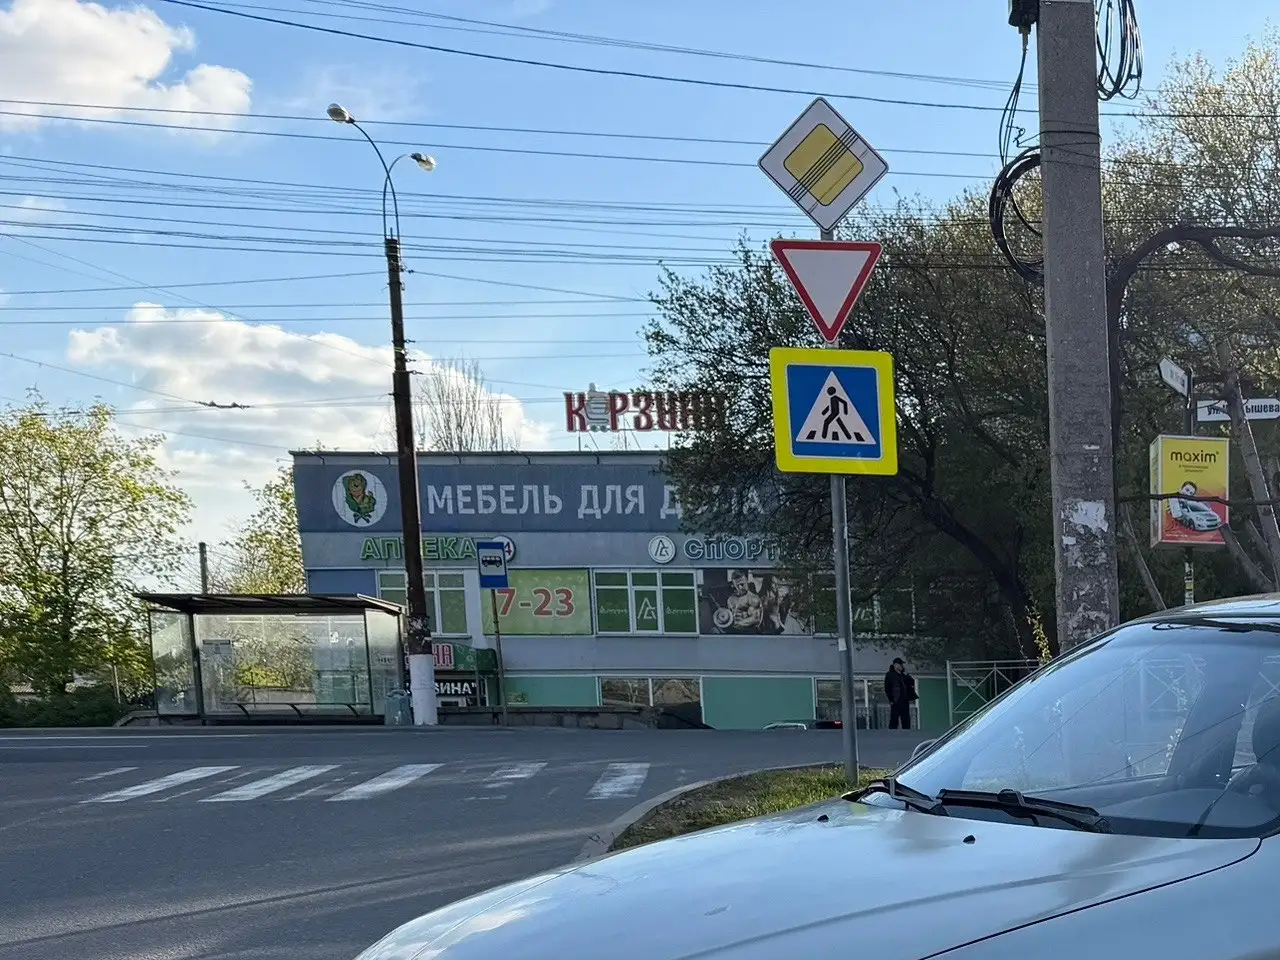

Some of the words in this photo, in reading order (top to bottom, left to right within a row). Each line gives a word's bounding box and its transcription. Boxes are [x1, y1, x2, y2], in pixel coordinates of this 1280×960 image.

[1170, 449, 1217, 463] maxim
[427, 484, 563, 515] МЕБЕЛЬ
[577, 484, 645, 519] ДЛЯ
[360, 536, 478, 561] АПЕКА
